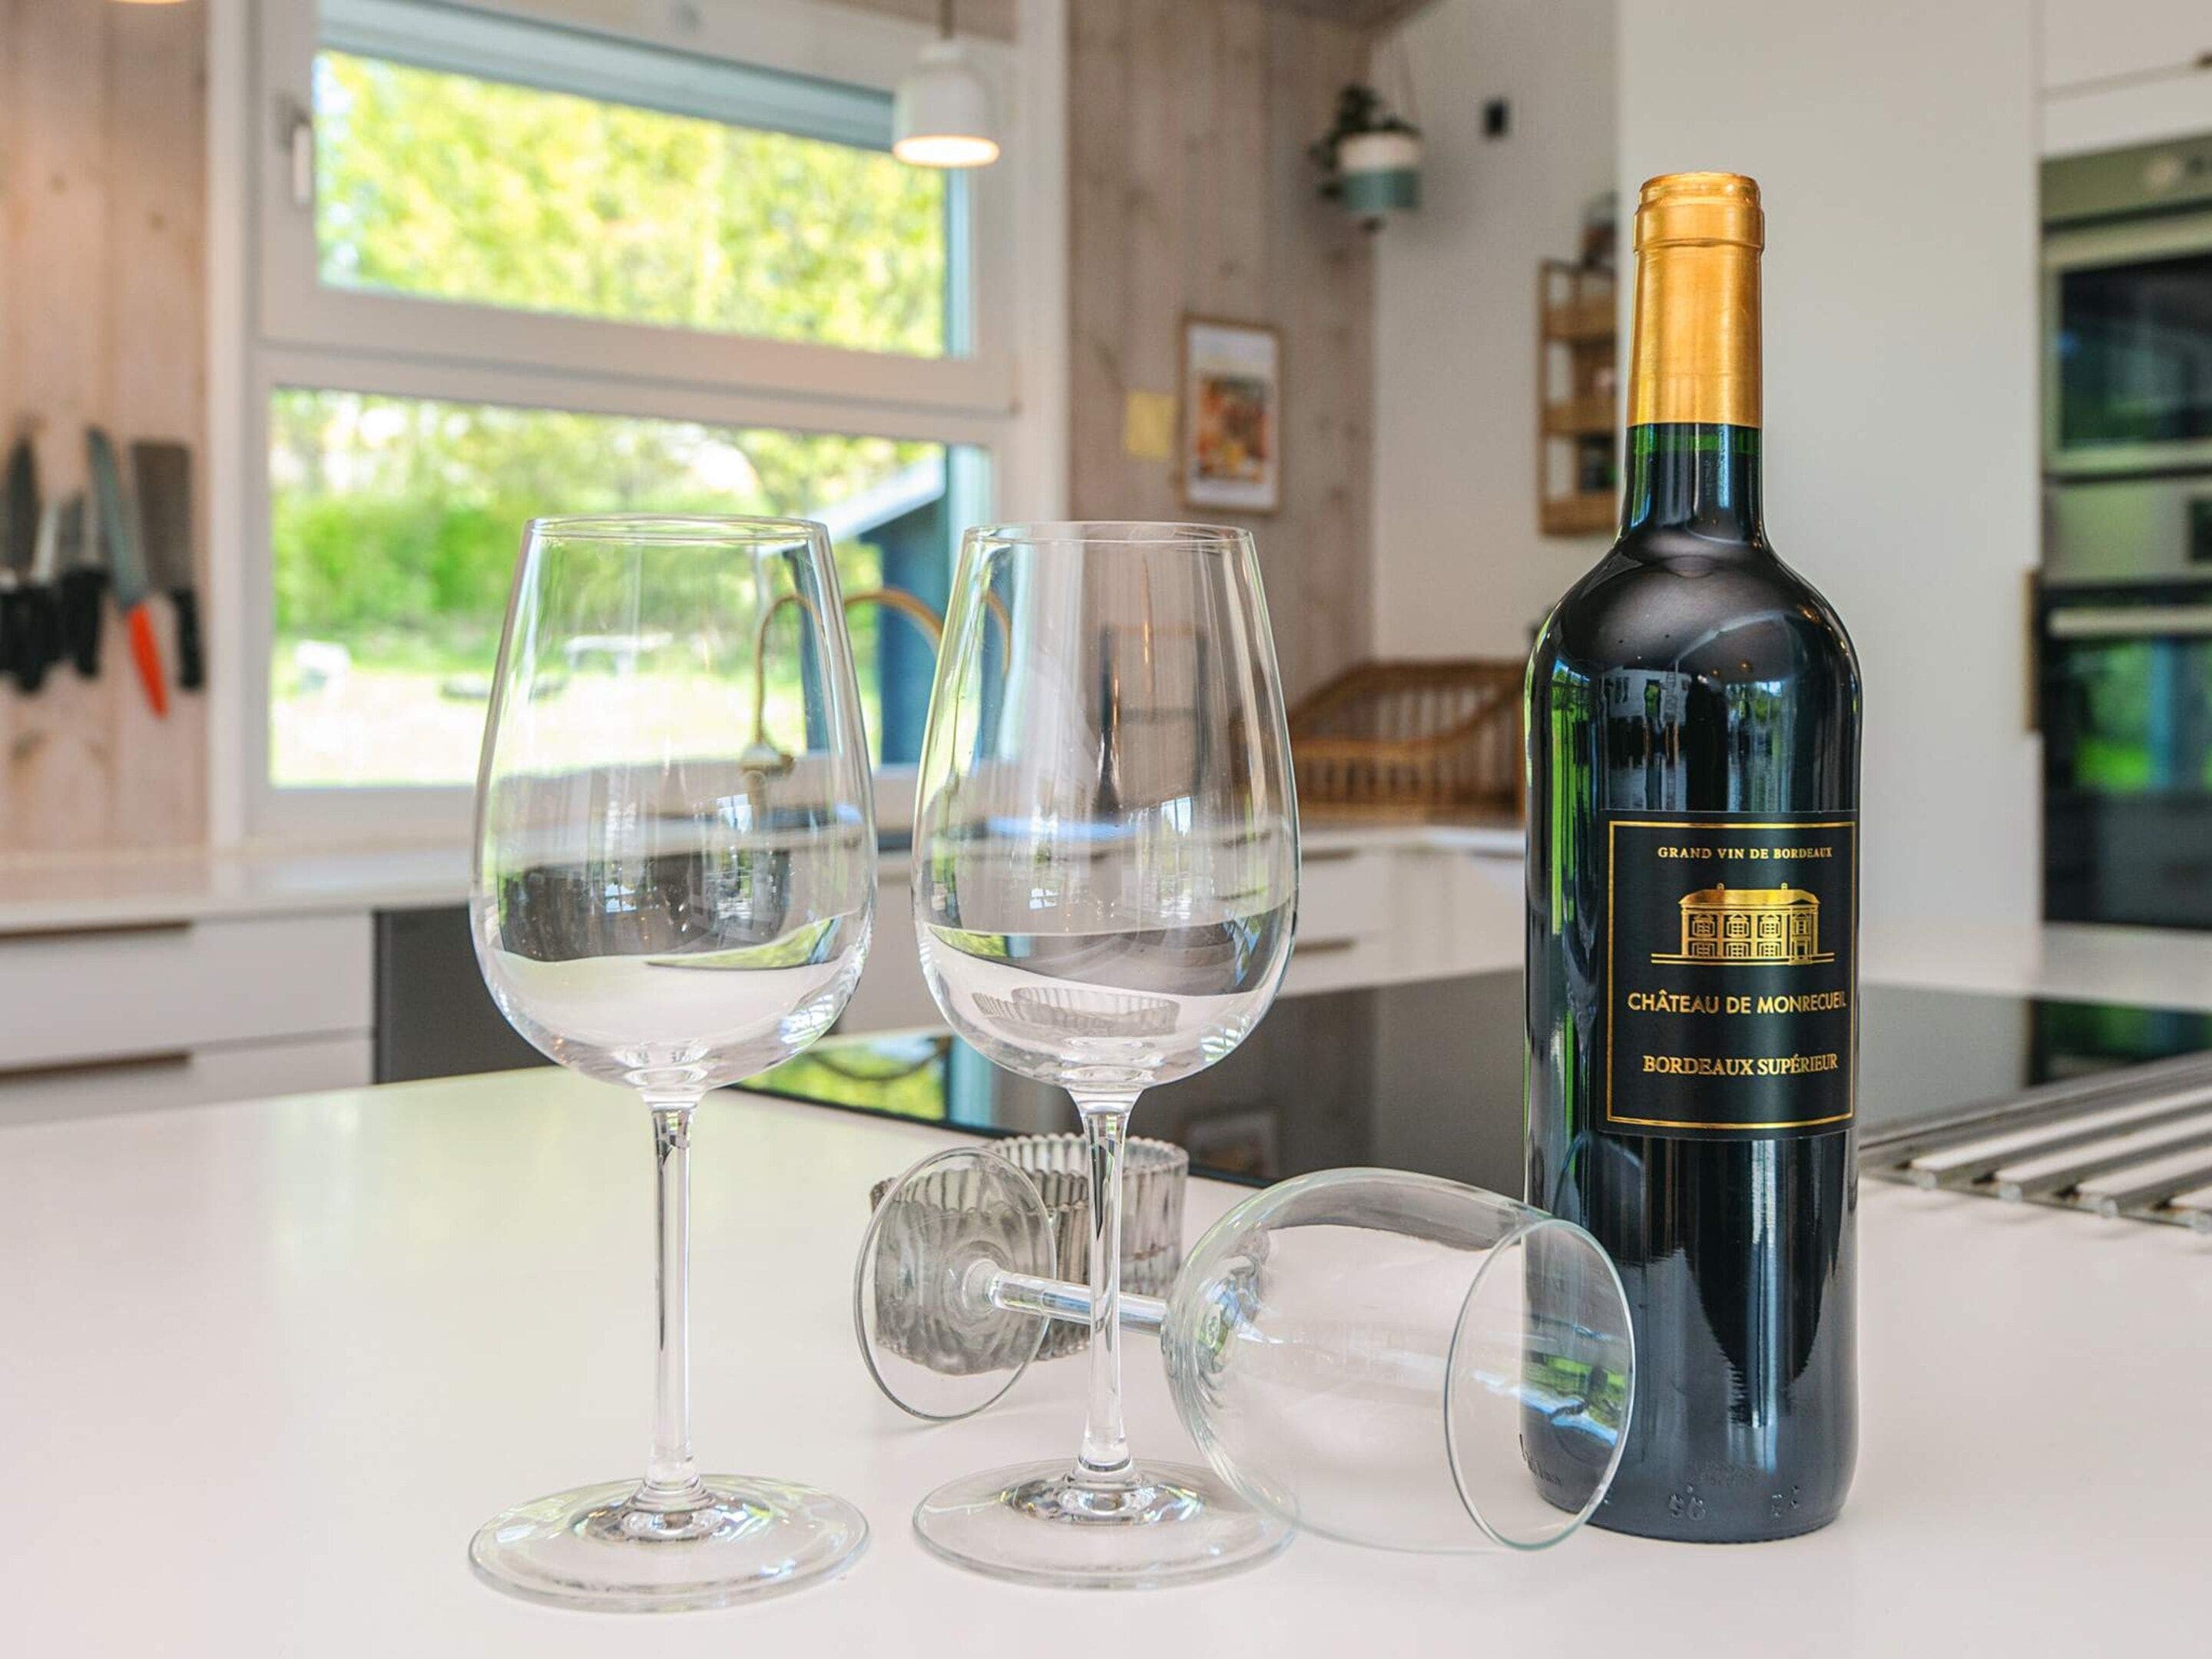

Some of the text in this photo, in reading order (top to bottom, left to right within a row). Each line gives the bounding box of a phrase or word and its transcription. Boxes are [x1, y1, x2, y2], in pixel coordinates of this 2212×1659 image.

[1657, 846, 1833, 859] GRAND VIN DE BORDEAUX
[1627, 988, 1720, 1014] CHÂTEAU
[1726, 995, 1752, 1014] DE
[1642, 1052, 1838, 1075] BORDEAUX SUPÉRIEUR
